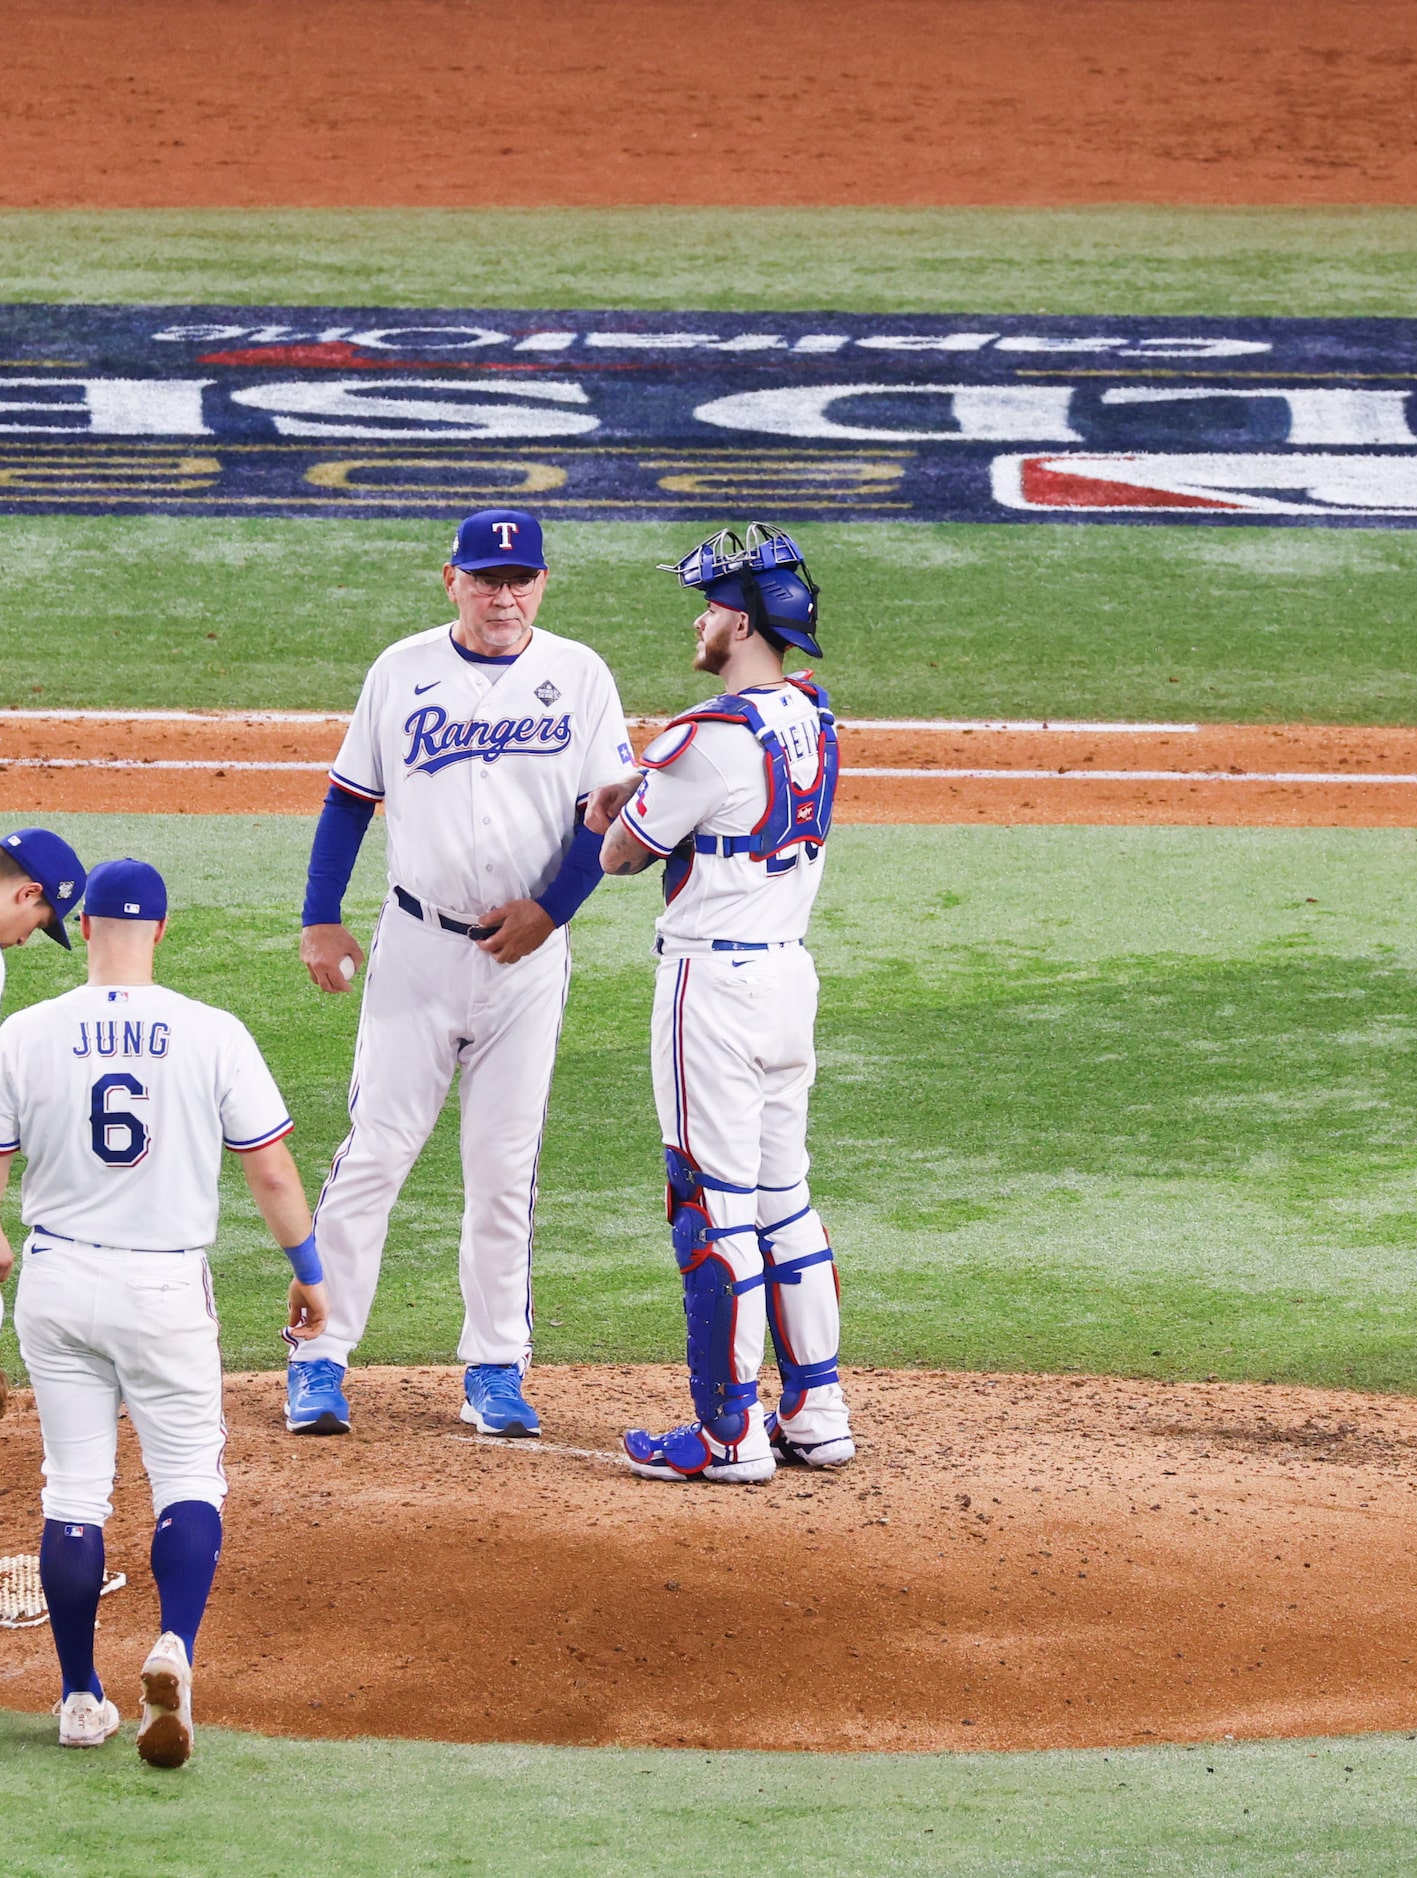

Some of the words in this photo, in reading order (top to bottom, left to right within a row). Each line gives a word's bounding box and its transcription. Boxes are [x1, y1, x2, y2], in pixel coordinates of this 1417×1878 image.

[492, 522, 520, 550] T
[403, 704, 573, 767] Rangers
[72, 1020, 171, 1059] JUNG
[89, 1073, 151, 1168] 6
